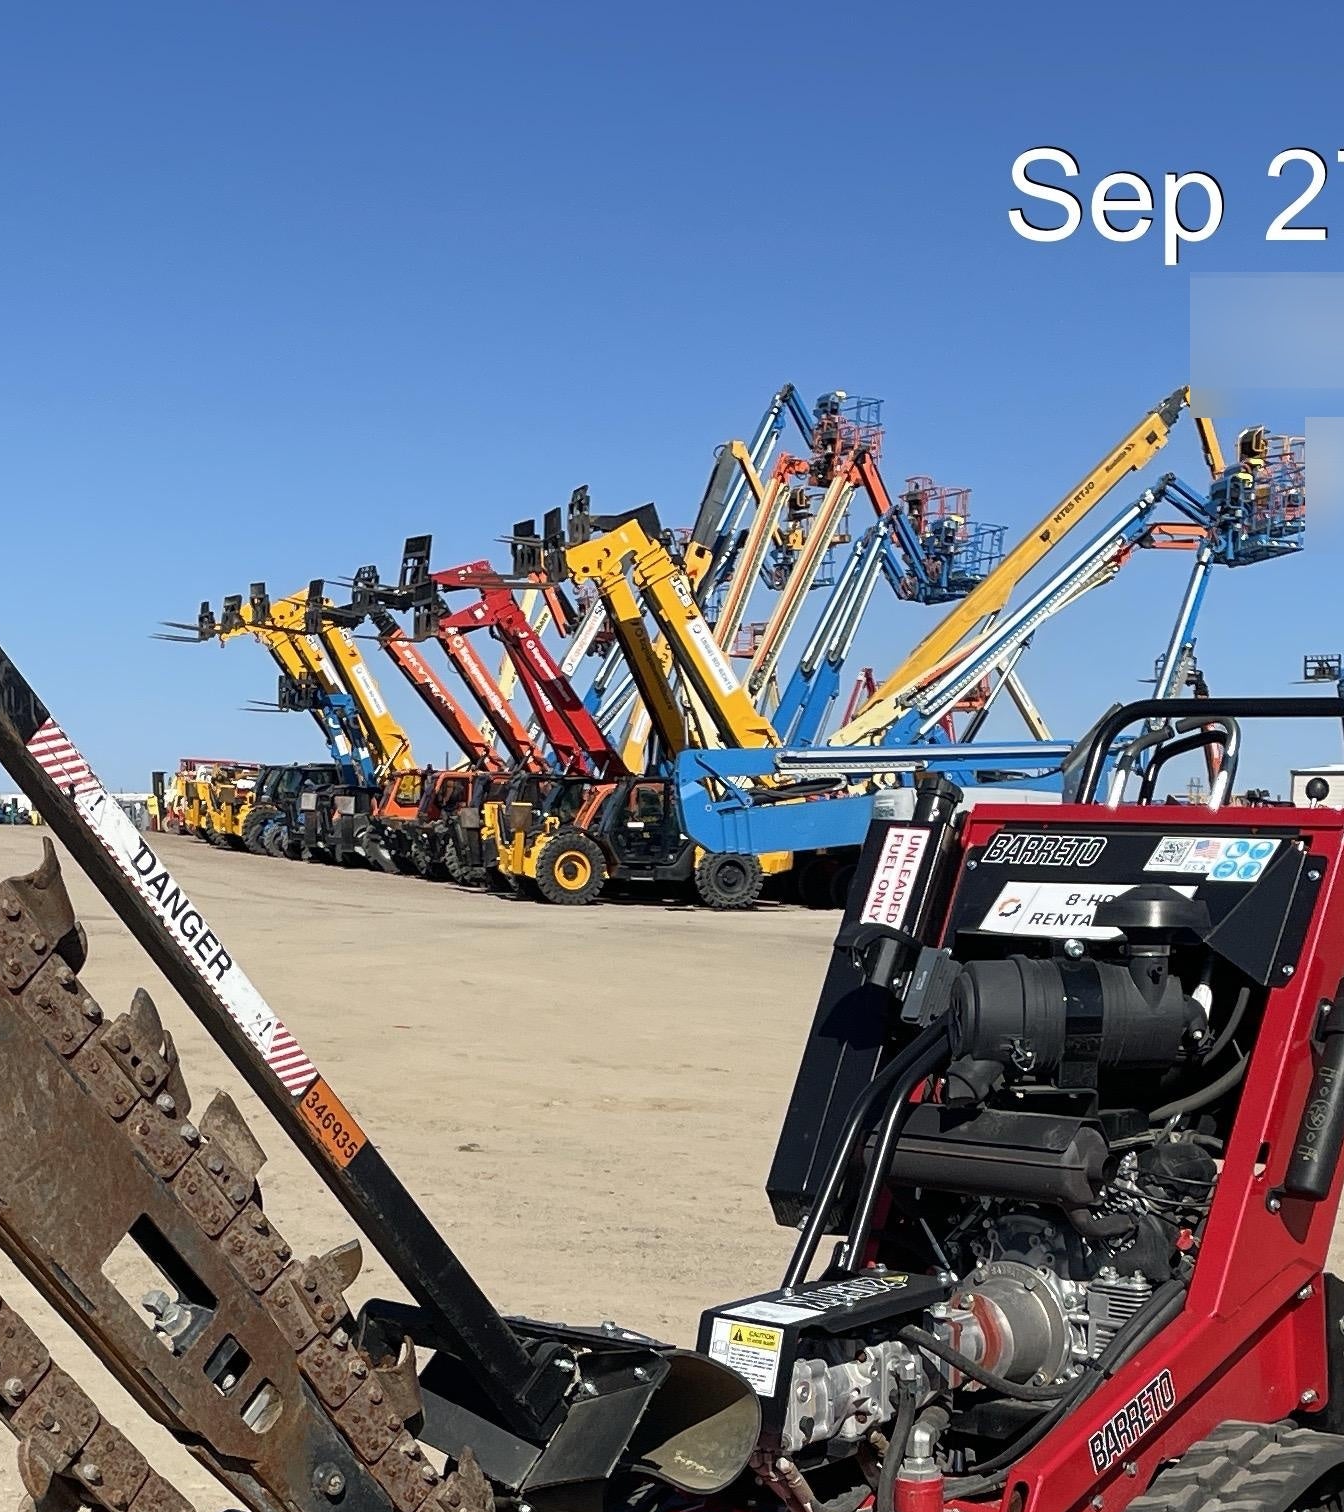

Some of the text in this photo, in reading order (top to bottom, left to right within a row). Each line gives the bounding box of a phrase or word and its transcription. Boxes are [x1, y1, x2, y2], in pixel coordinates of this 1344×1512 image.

[882, 834, 904, 874] FUEL
[981, 834, 1107, 867] BARRETO
[868, 879, 889, 922] ONLY
[886, 835, 923, 924] UNLEADED
[1065, 893, 1117, 906] 8-HO
[132, 843, 233, 982] DANGER
[1028, 913, 1092, 927] RENTA
[305, 1091, 358, 1158] 346935
[1088, 1368, 1176, 1475] BARRETO
